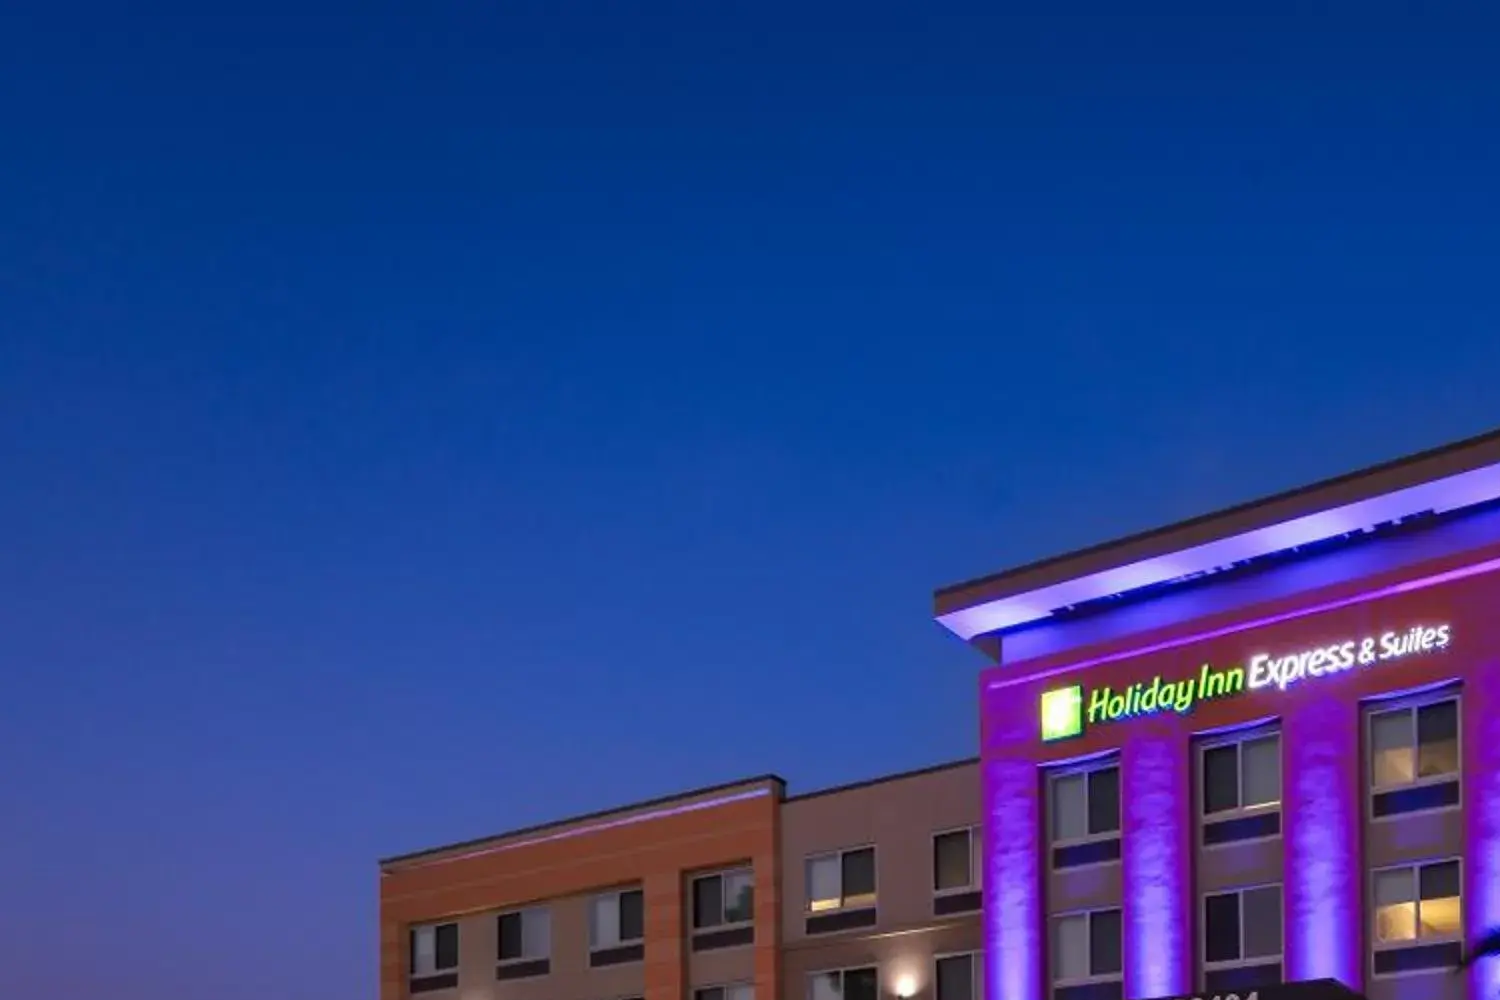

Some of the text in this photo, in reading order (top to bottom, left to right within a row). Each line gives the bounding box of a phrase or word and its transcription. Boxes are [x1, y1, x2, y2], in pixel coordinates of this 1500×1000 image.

[1088, 625, 1449, 723] Holiday Inn Express & Suites
